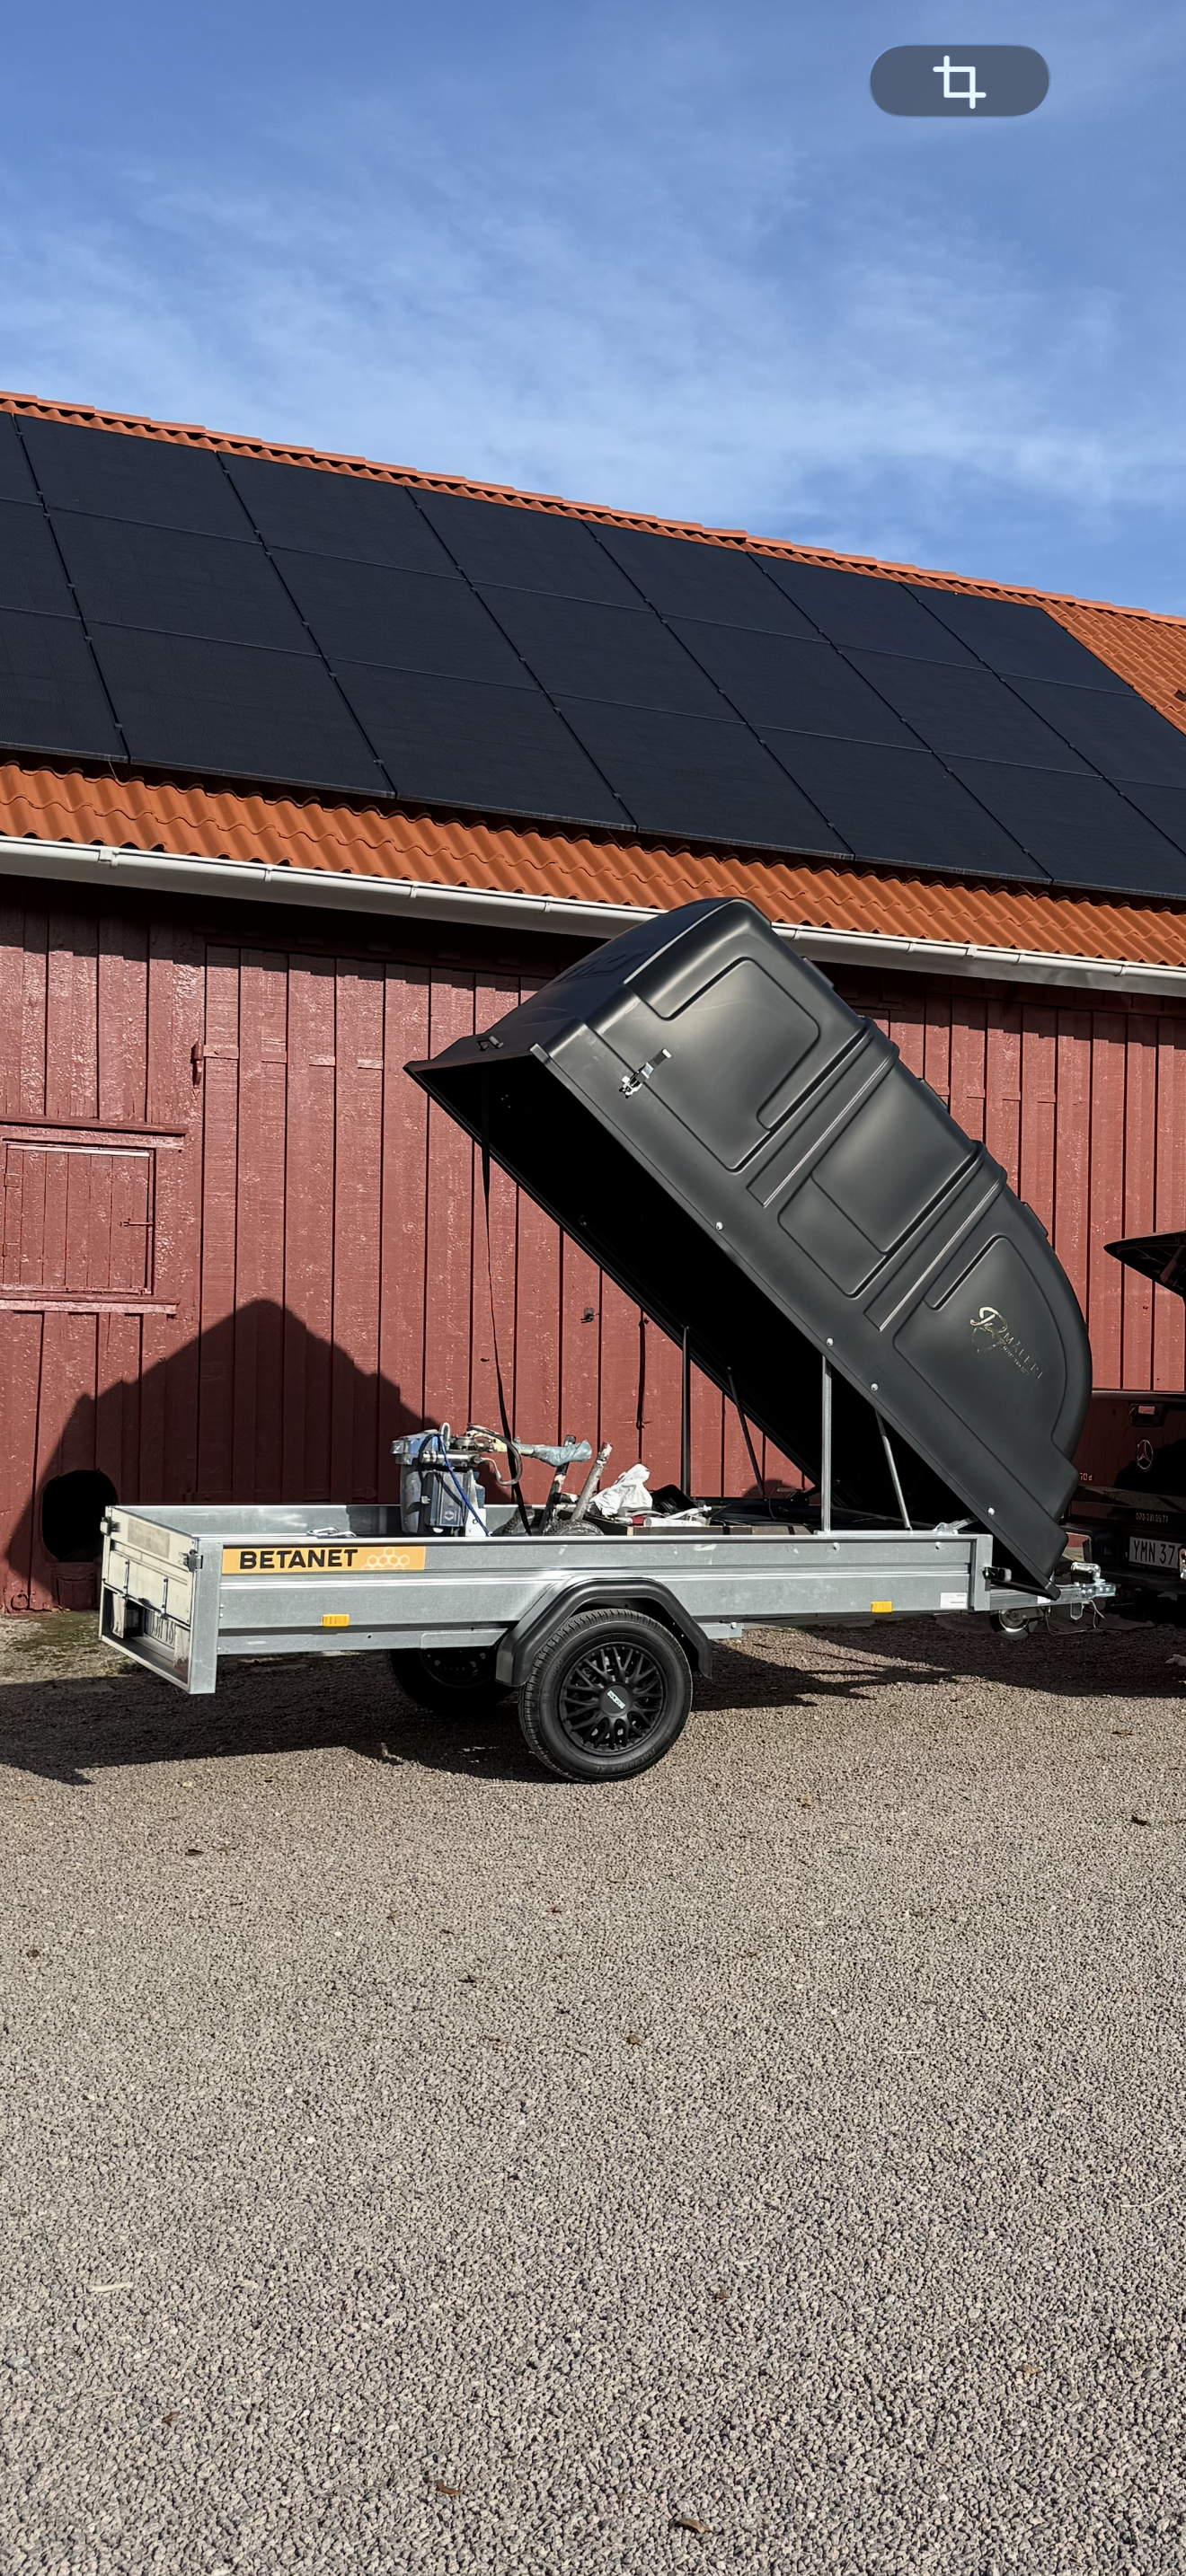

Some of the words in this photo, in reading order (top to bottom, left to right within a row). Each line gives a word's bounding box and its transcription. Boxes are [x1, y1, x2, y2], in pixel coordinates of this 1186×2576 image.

[240, 1548, 358, 1569] BETANET
[1134, 1539, 1155, 1563] YMN
[1160, 1543, 1177, 1565] 37
